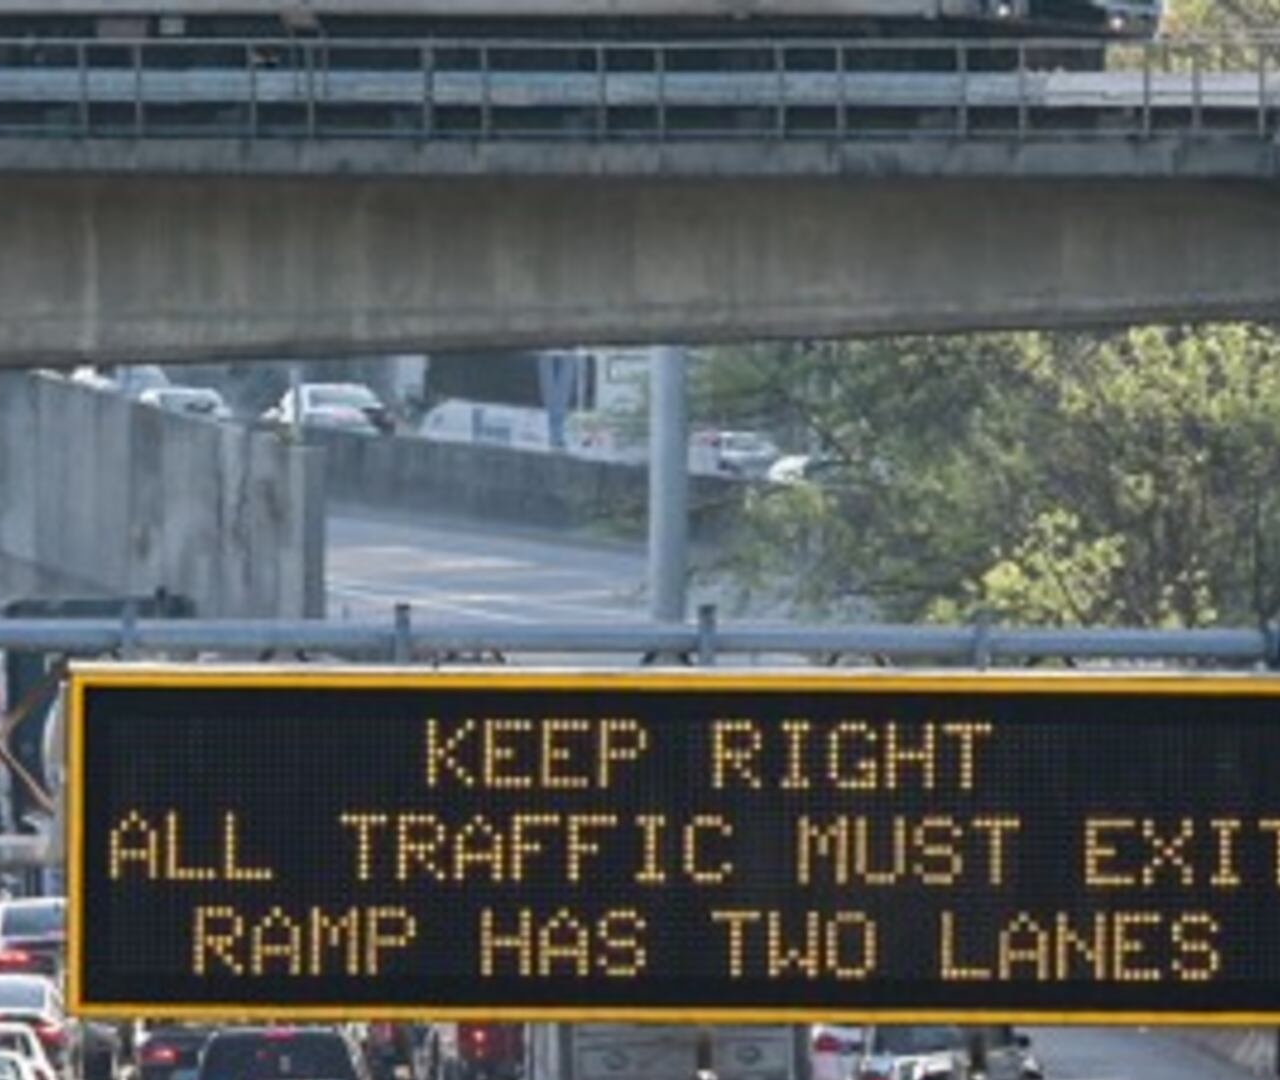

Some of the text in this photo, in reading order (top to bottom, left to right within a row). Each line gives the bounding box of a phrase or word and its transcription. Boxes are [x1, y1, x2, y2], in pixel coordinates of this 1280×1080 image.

[426, 718, 993, 789] KEEP RIGHT
[109, 811, 273, 881] ALL
[339, 813, 733, 883] TRAFFIC
[797, 815, 1021, 885] MUST
[193, 905, 1220, 981] RAMP HAS TWO LANES
